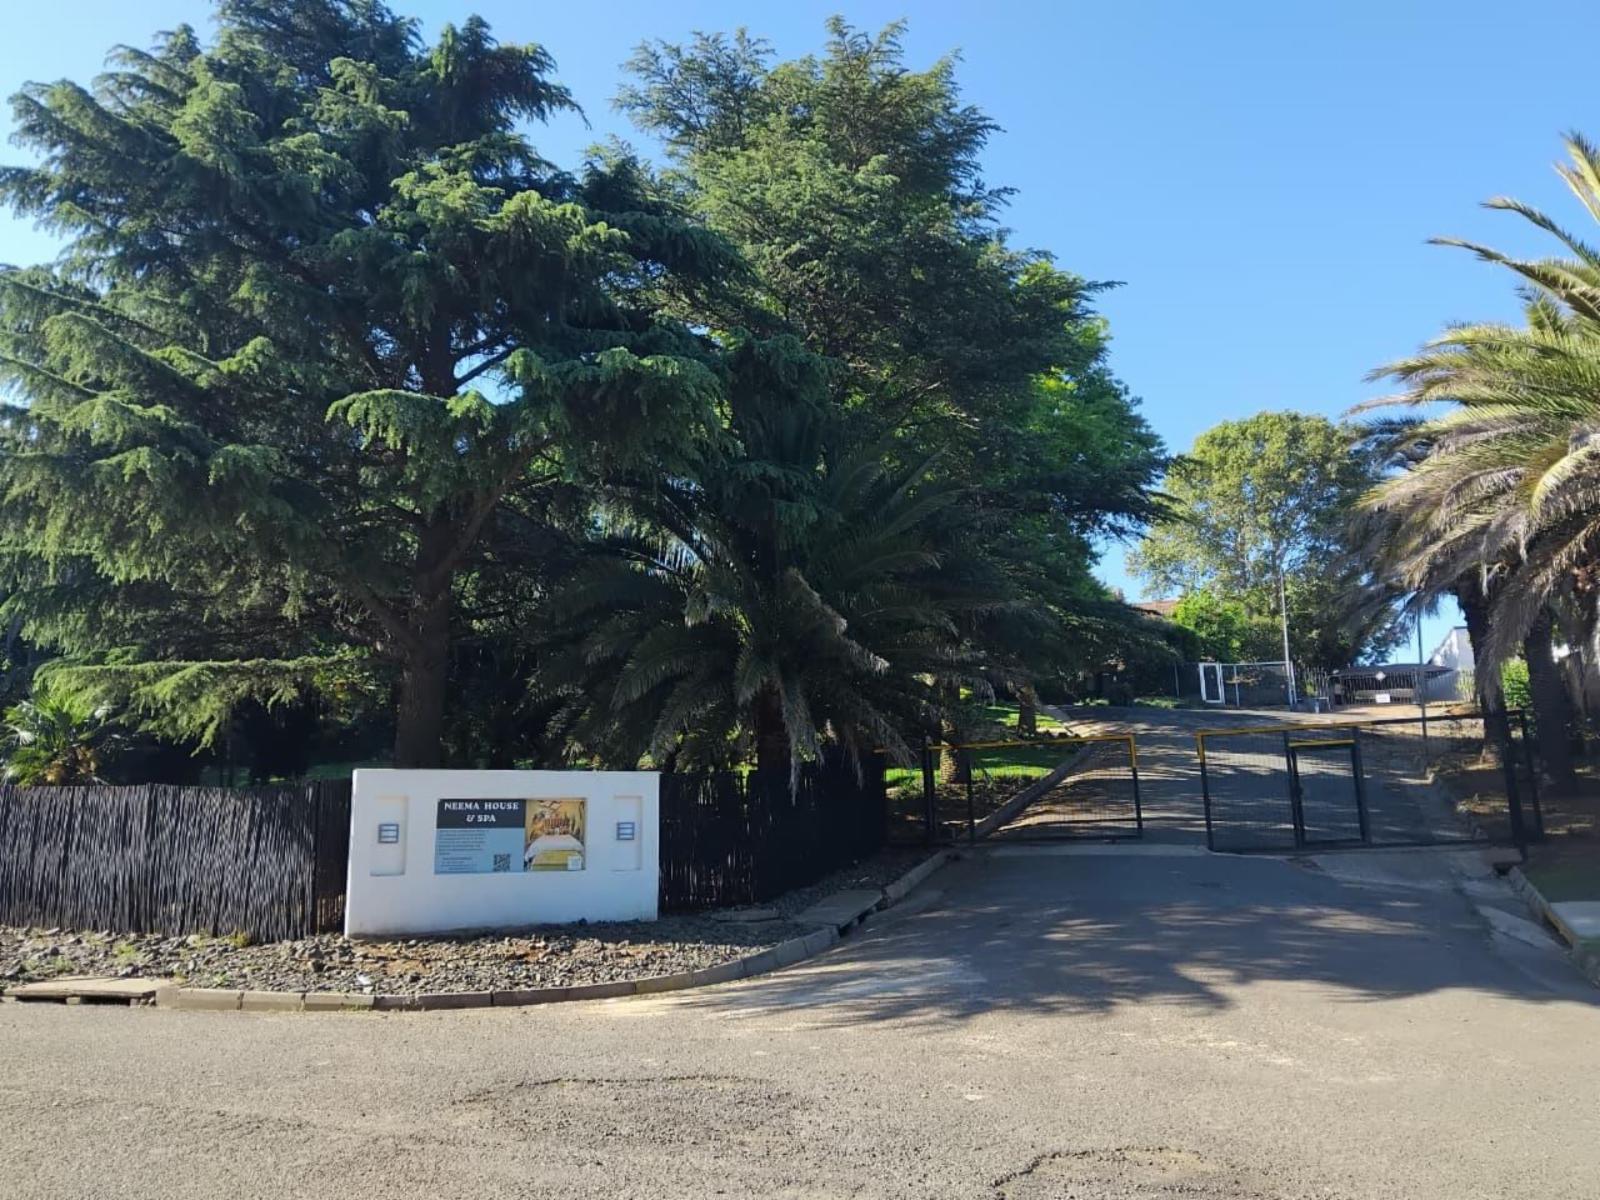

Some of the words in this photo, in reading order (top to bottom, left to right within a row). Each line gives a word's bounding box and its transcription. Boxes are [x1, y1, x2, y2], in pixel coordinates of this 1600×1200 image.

[444, 802, 480, 811] NEEMA
[484, 802, 519, 810] HOUSE
[466, 814, 475, 822] &
[477, 814, 496, 822] SPA
